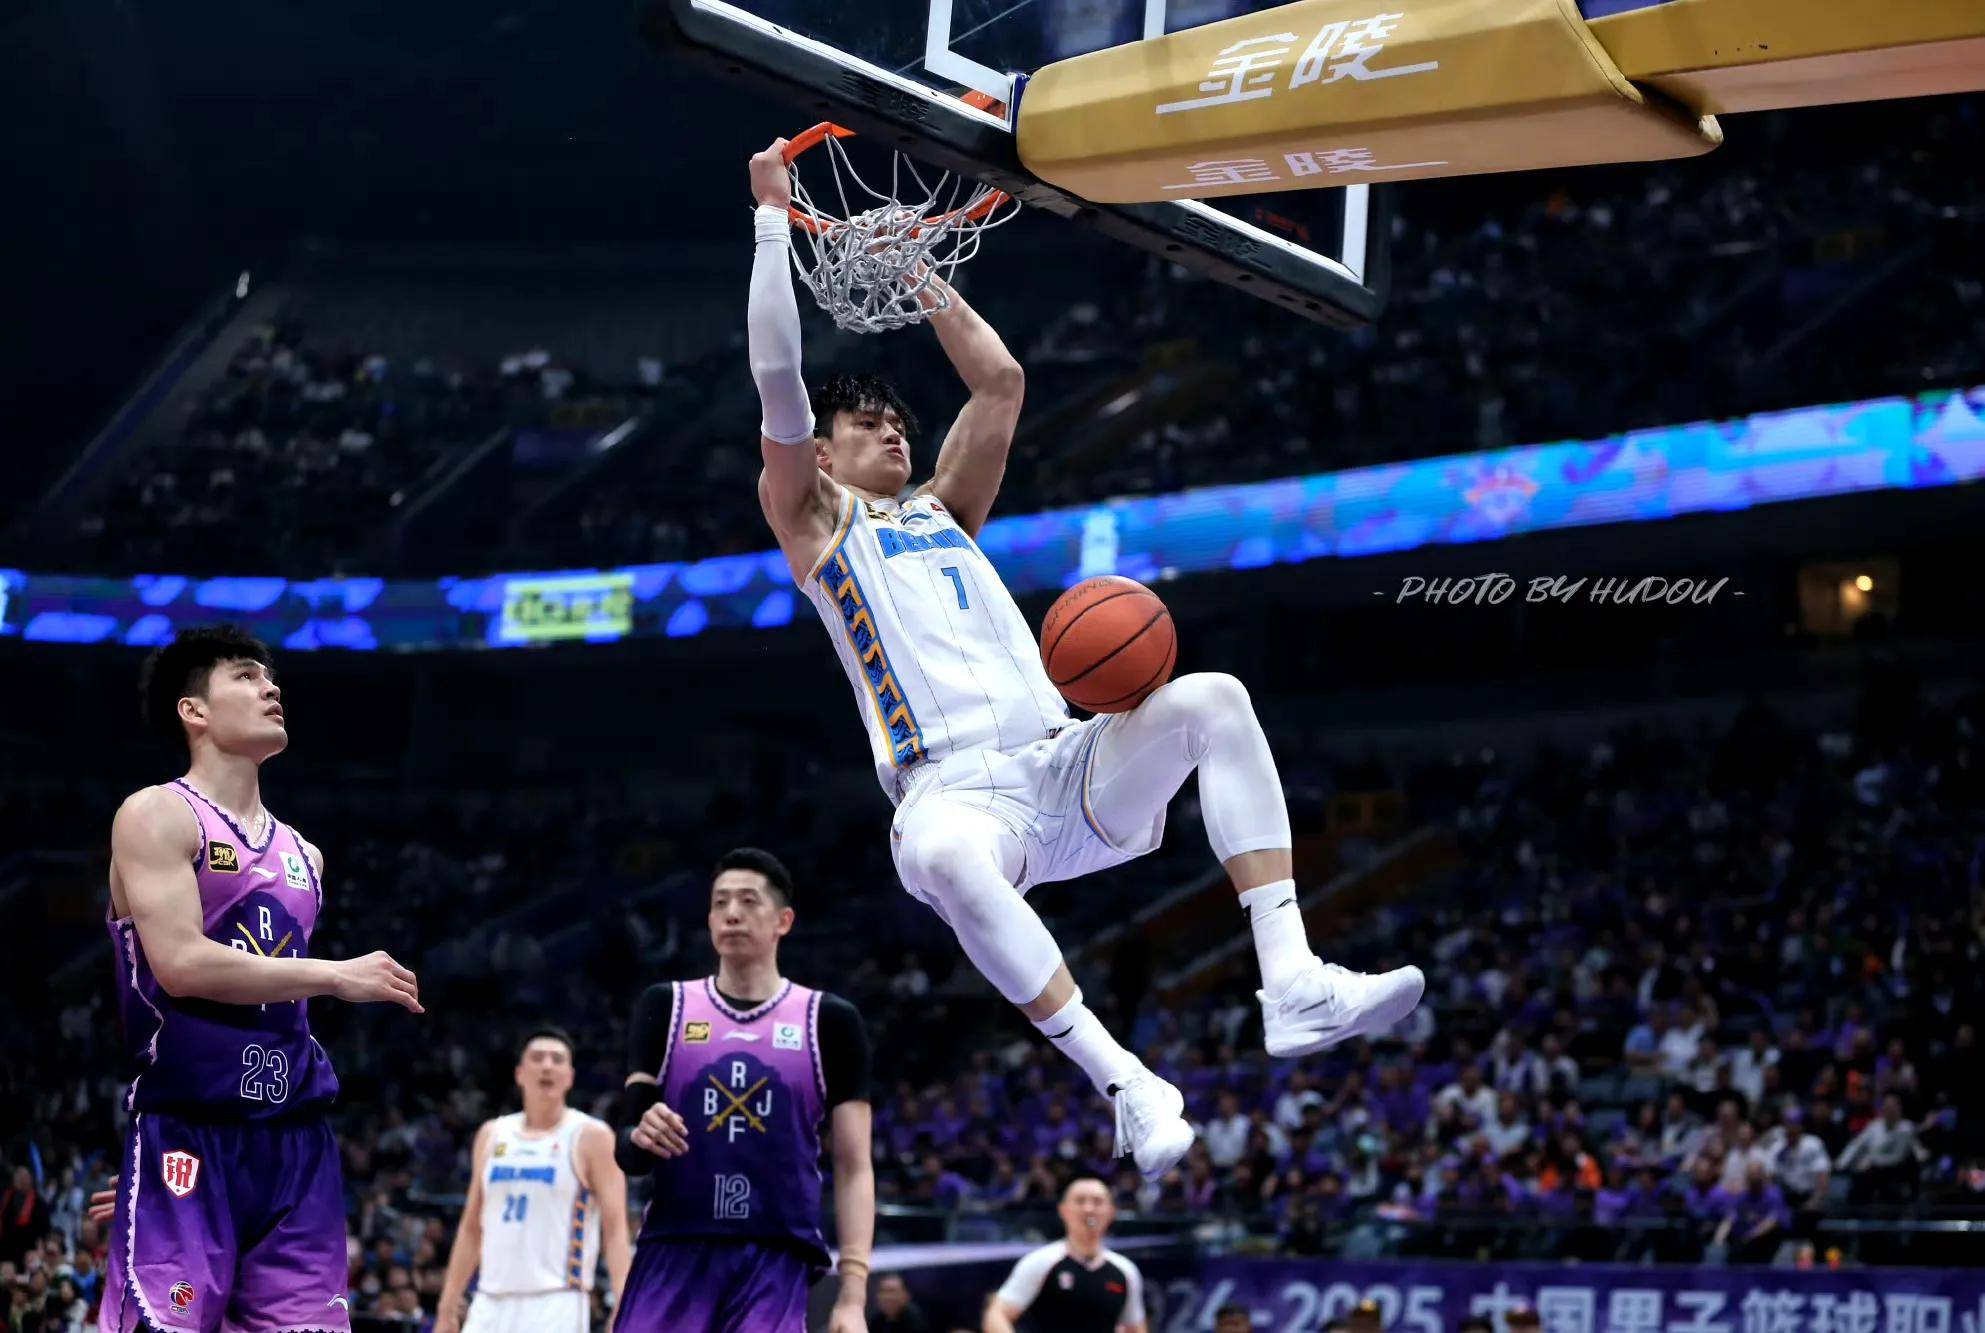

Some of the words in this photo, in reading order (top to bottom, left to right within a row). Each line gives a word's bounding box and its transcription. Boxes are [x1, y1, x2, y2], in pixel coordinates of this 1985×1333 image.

[1156, 13, 1439, 115] 金陵
[1161, 147, 1448, 190] 金陵
[940, 566, 969, 610] 7
[258, 905, 274, 941] R
[240, 1044, 289, 1104] 23
[731, 1061, 747, 1088] R
[704, 1088, 718, 1116] B
[756, 1089, 772, 1117] J
[728, 1116, 746, 1143] F
[502, 1193, 529, 1223] 20
[713, 1174, 750, 1219] 12
